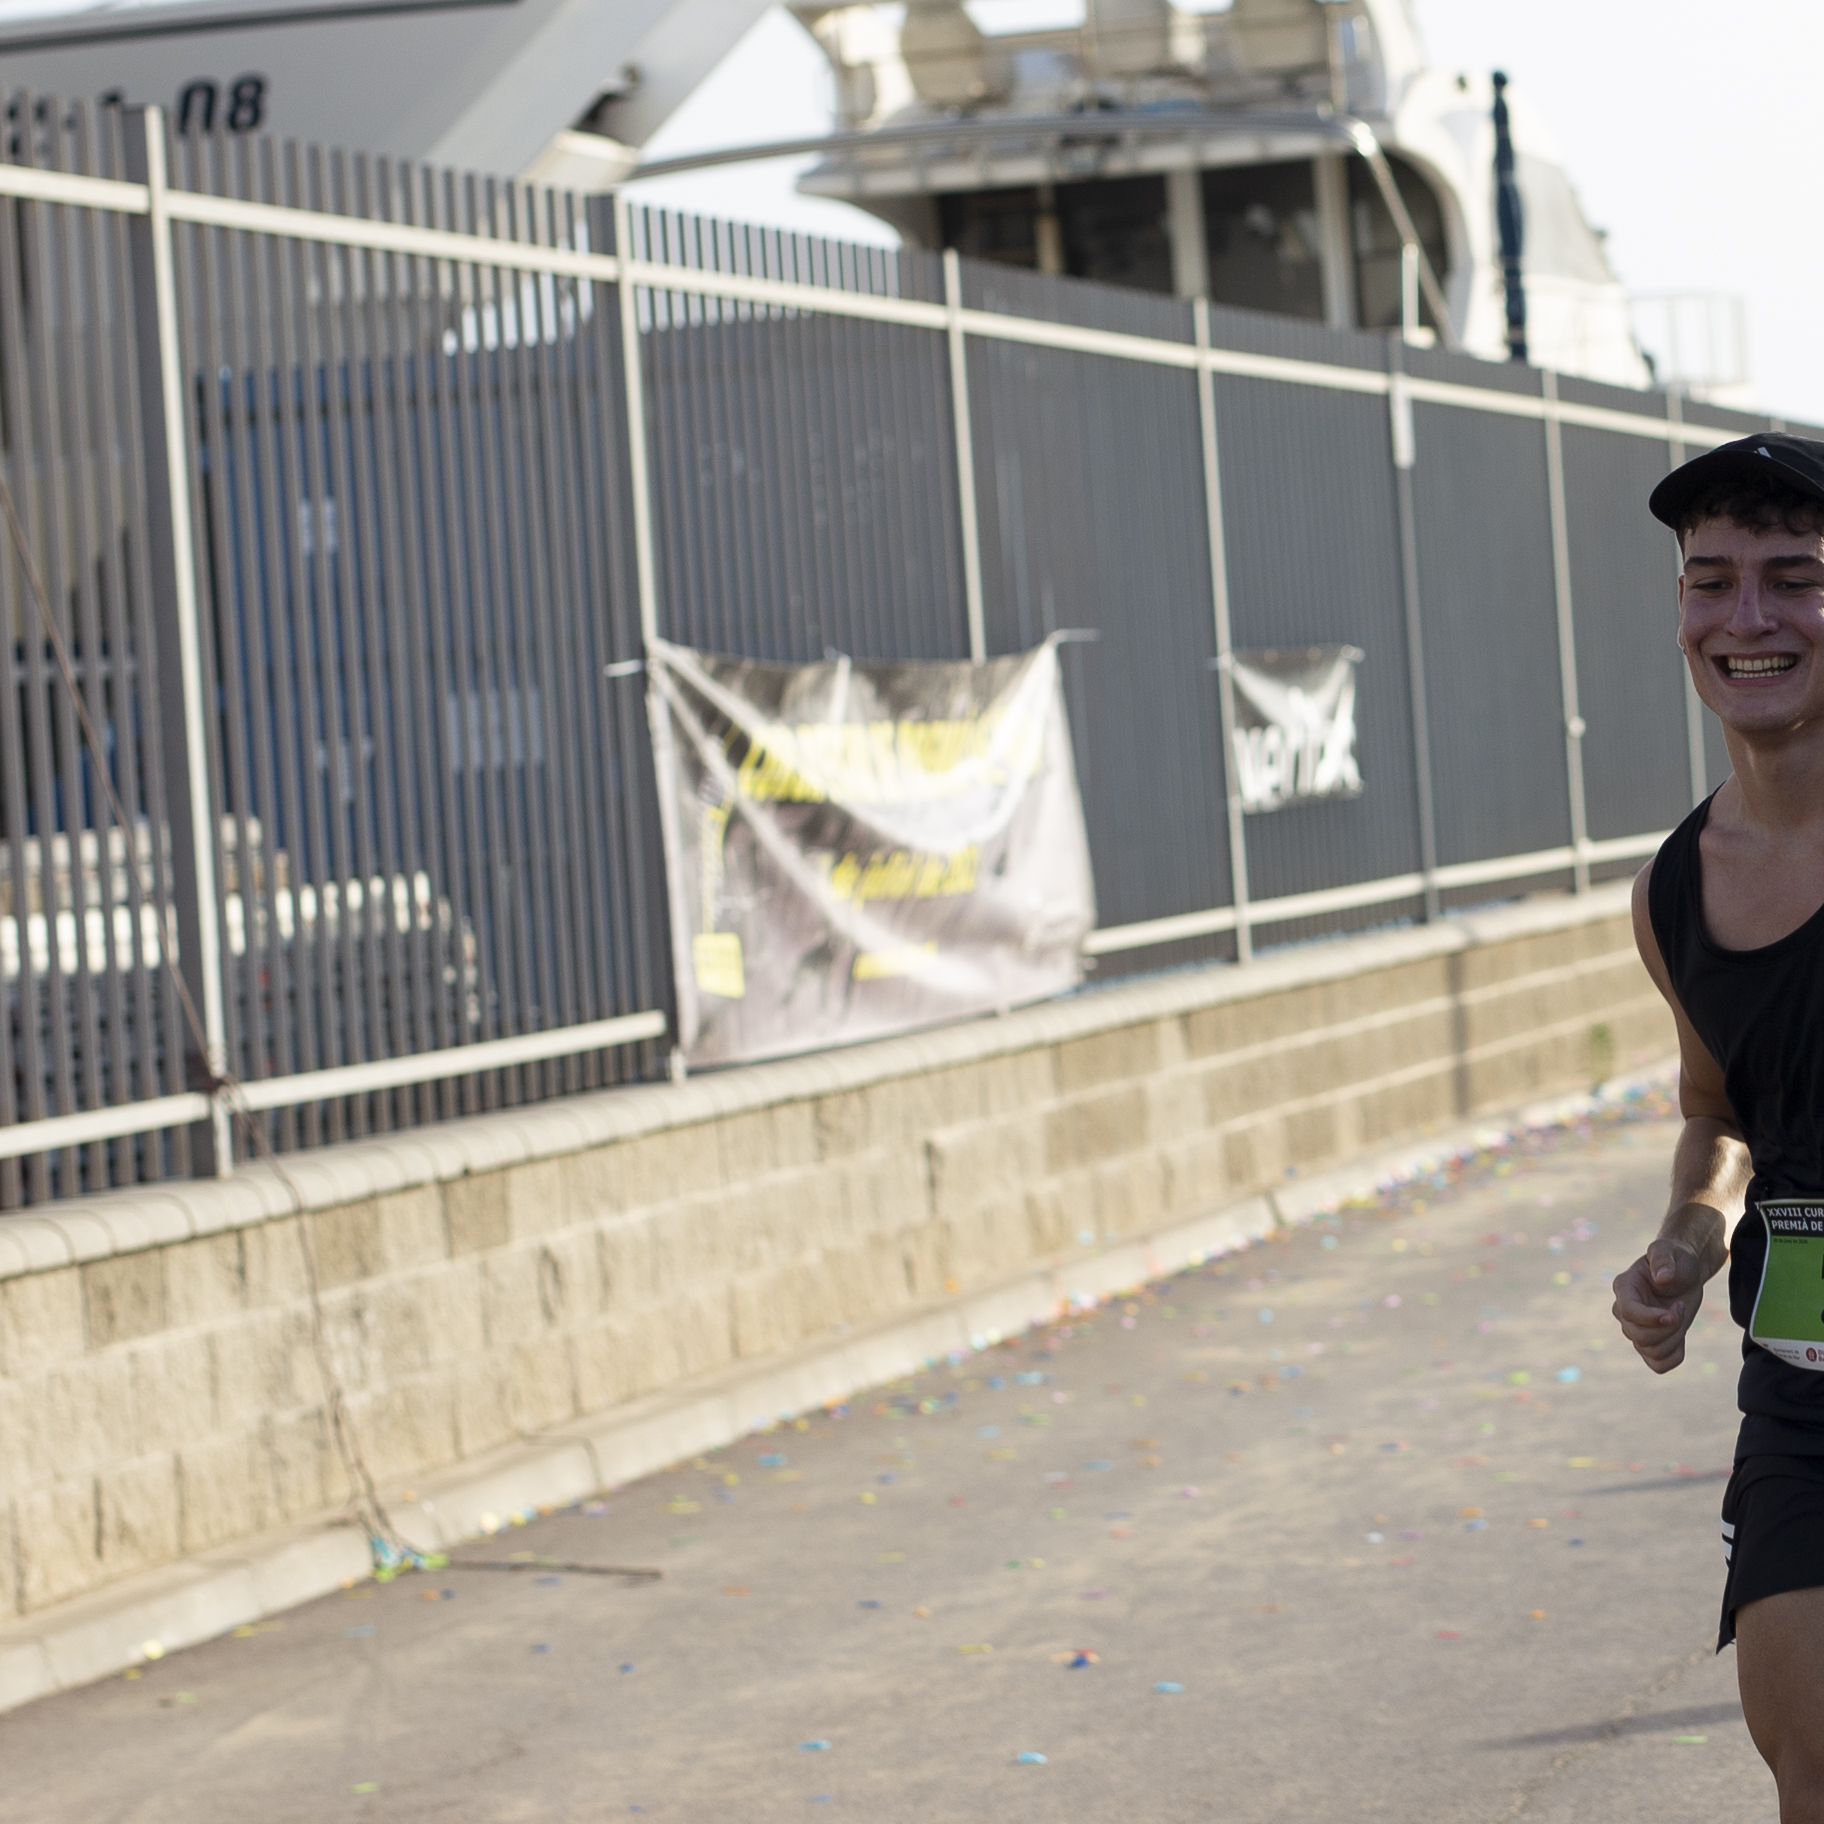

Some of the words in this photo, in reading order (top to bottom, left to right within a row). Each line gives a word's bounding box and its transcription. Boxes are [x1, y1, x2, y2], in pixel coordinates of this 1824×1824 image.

[1766, 1207, 1802, 1217] XXVIII
[1771, 1217, 1809, 1231] PREMIÀ
[1810, 1220, 1823, 1232] DE
